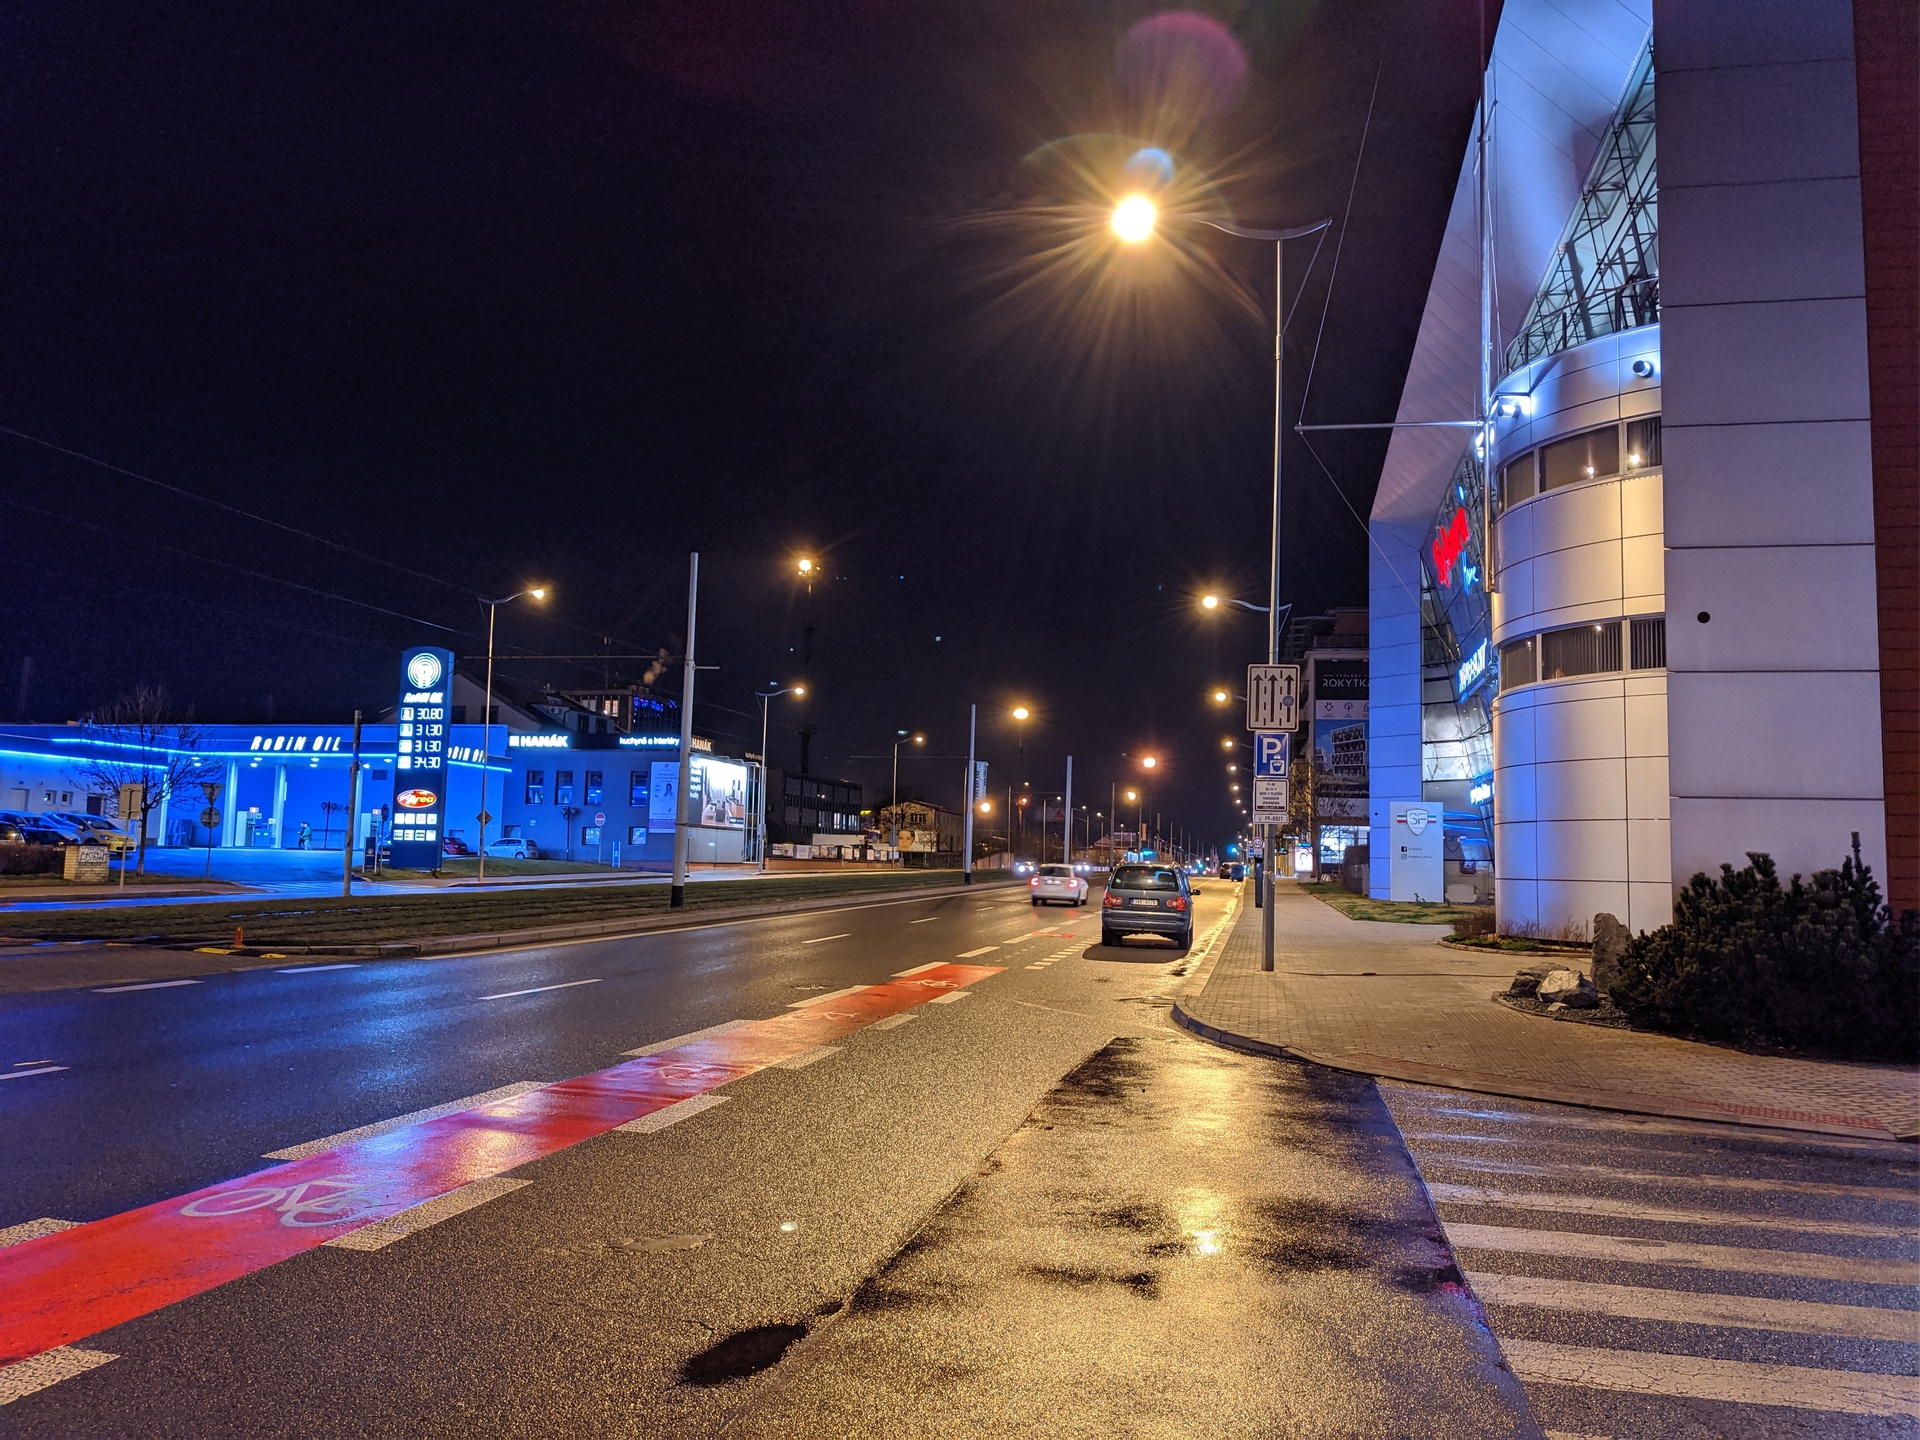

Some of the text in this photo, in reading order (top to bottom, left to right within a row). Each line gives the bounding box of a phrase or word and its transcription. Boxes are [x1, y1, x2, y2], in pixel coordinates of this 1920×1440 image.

[417, 708, 443, 720] 30,80
[416, 724, 442, 737] 31,30
[312, 735, 341, 751] OIL
[414, 740, 441, 753] 31,30
[520, 734, 568, 747] HANÁK
[692, 737, 712, 752] HANÁK
[1262, 737, 1282, 763] P
[413, 757, 441, 769] 34,30
